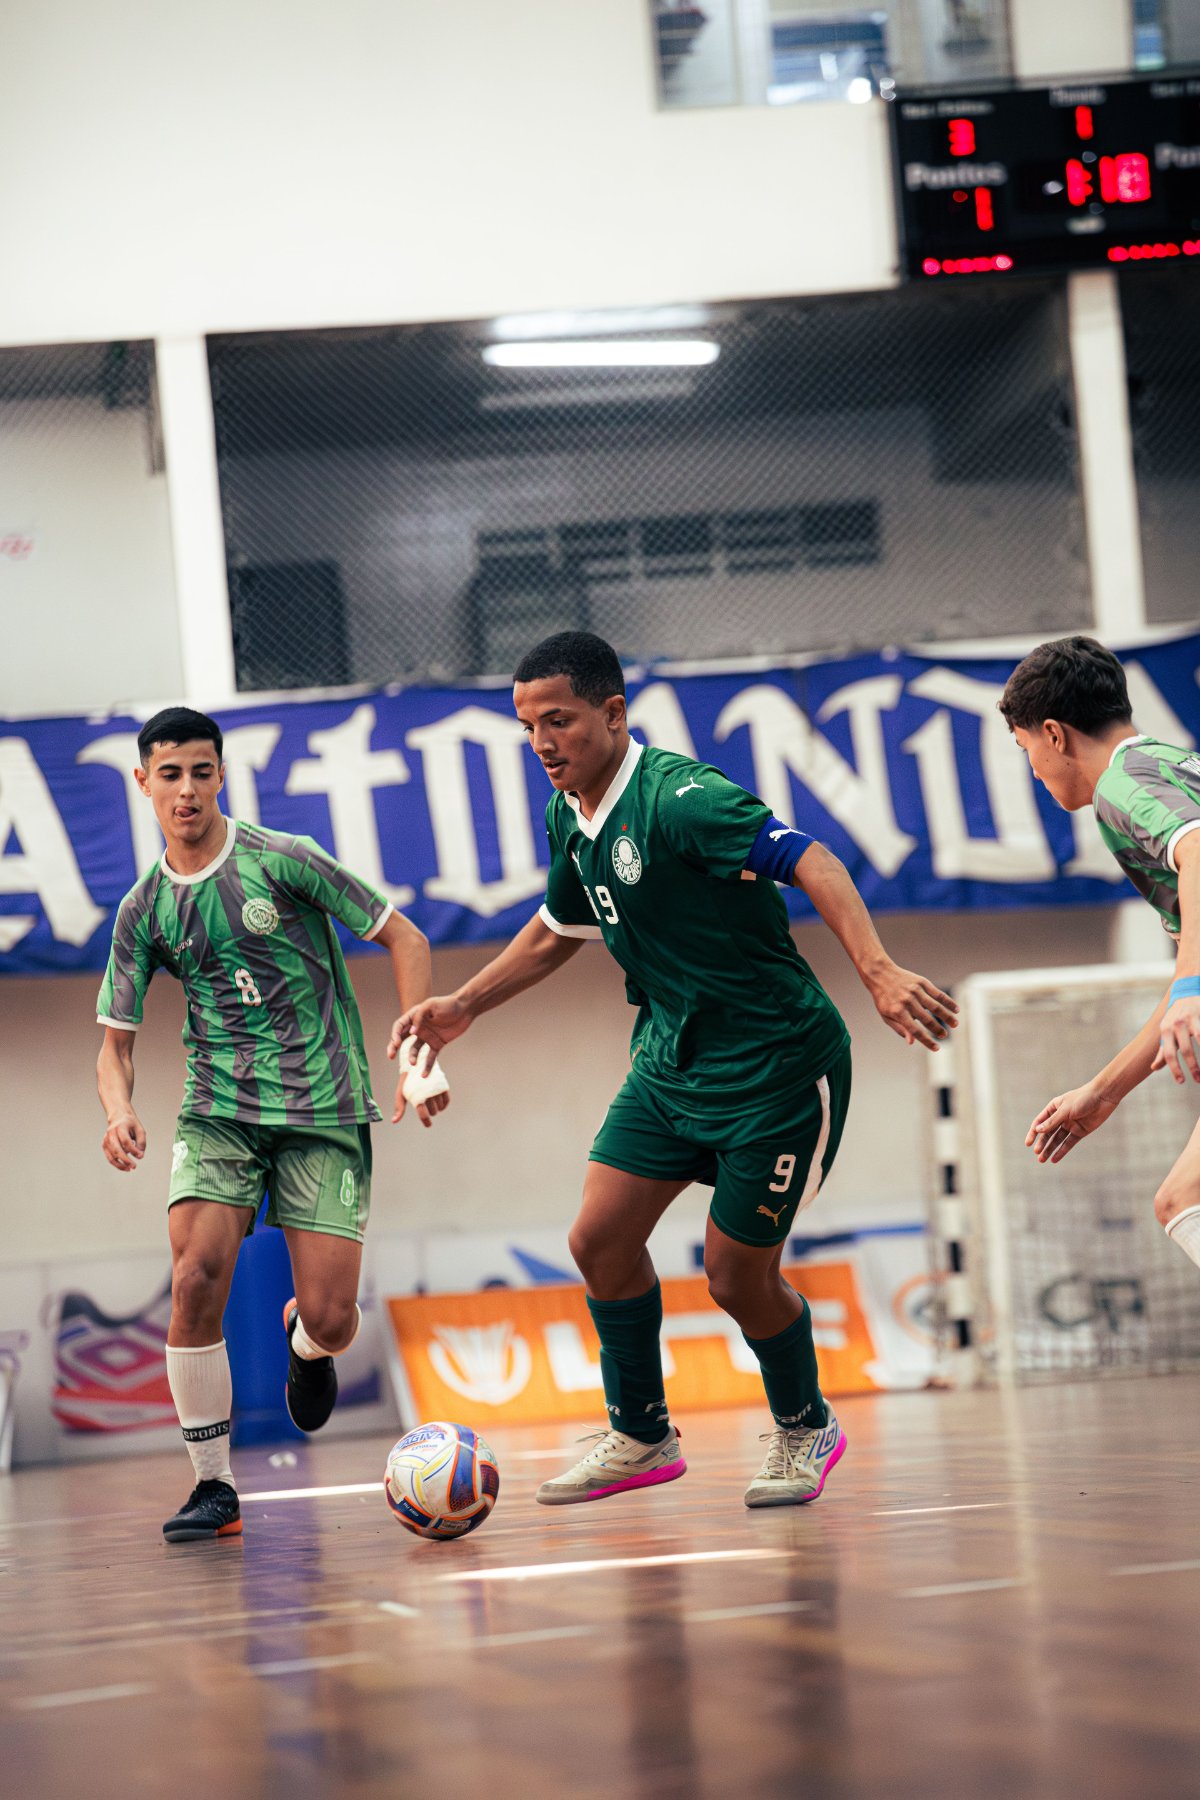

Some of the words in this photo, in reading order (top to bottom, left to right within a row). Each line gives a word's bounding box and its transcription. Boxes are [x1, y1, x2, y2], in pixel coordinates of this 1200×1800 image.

[234, 968, 262, 1007] 8
[340, 1168, 355, 1206] 8
[768, 1154, 797, 1193] 9
[183, 1422, 230, 1440] SPORTS
